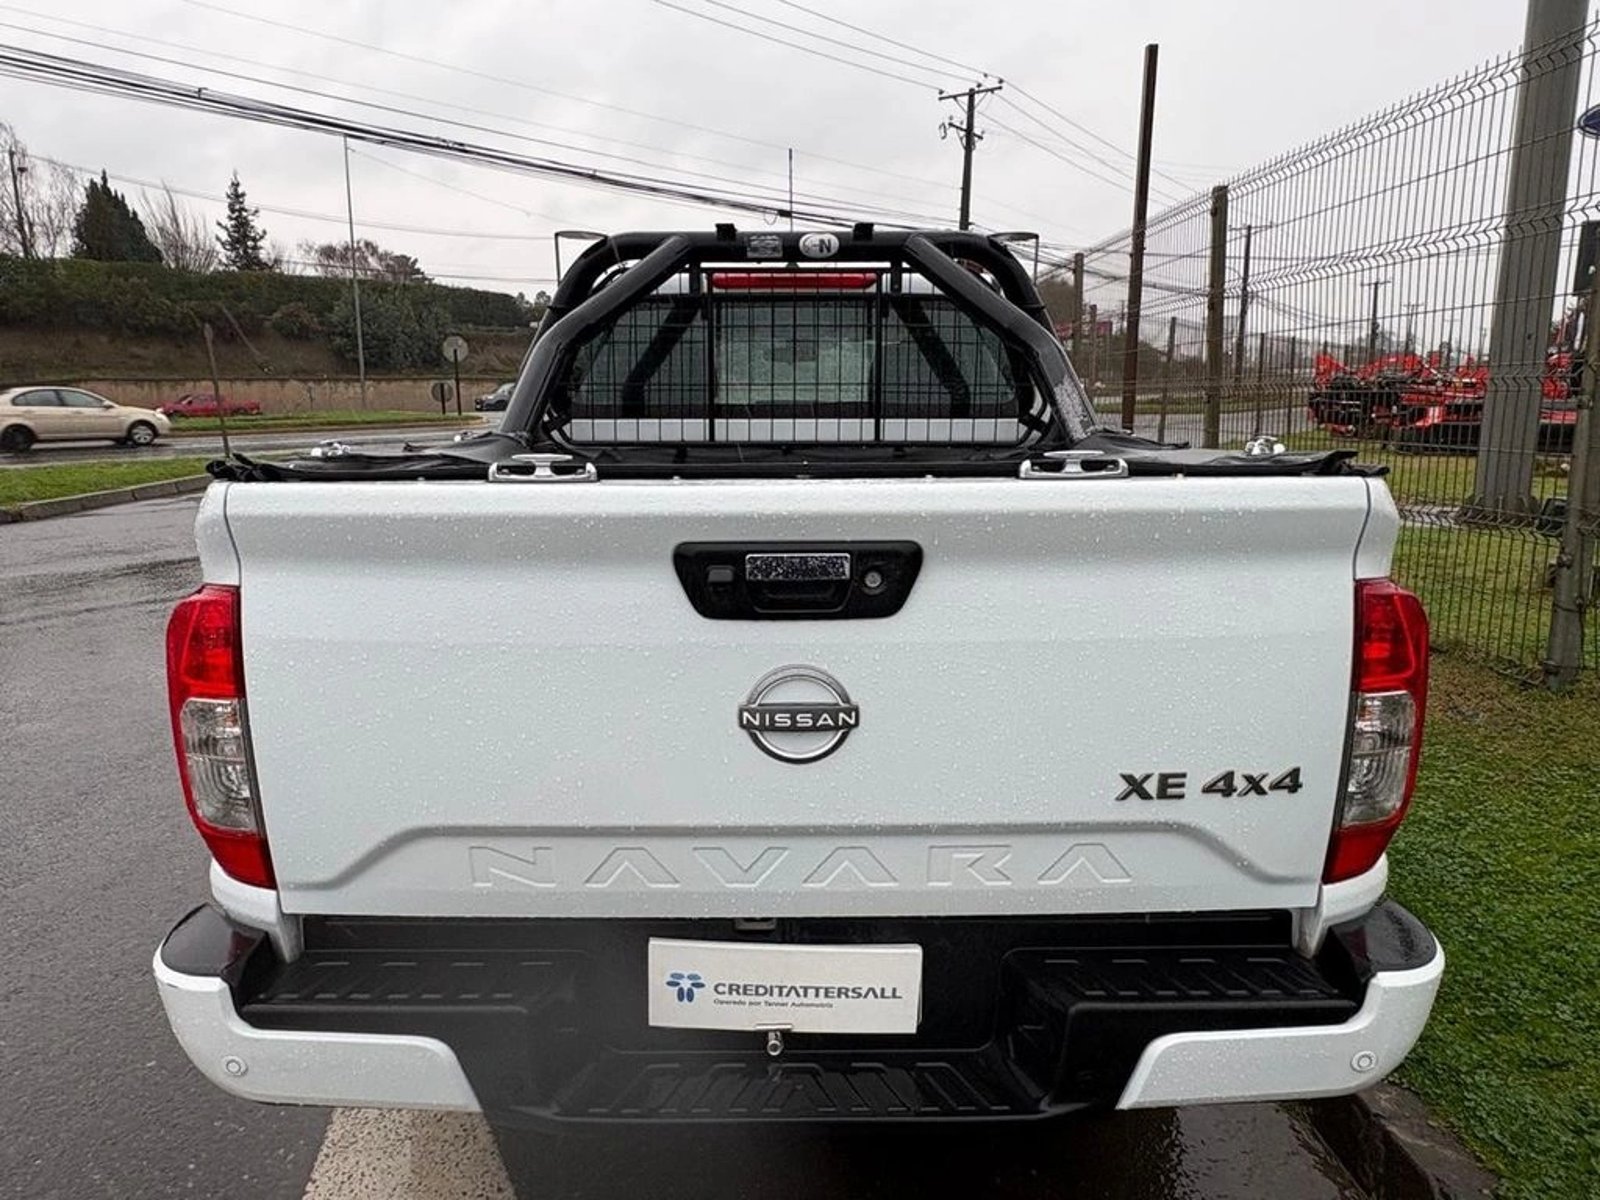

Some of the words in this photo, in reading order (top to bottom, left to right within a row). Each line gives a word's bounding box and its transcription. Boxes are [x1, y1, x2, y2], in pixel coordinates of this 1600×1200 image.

[742, 711, 856, 727] NISSAN
[1115, 772, 1188, 801] XE
[1201, 766, 1303, 798] 4x4
[468, 842, 1133, 887] NAVARA
[713, 982, 903, 1000] CREDITATTERSALL
